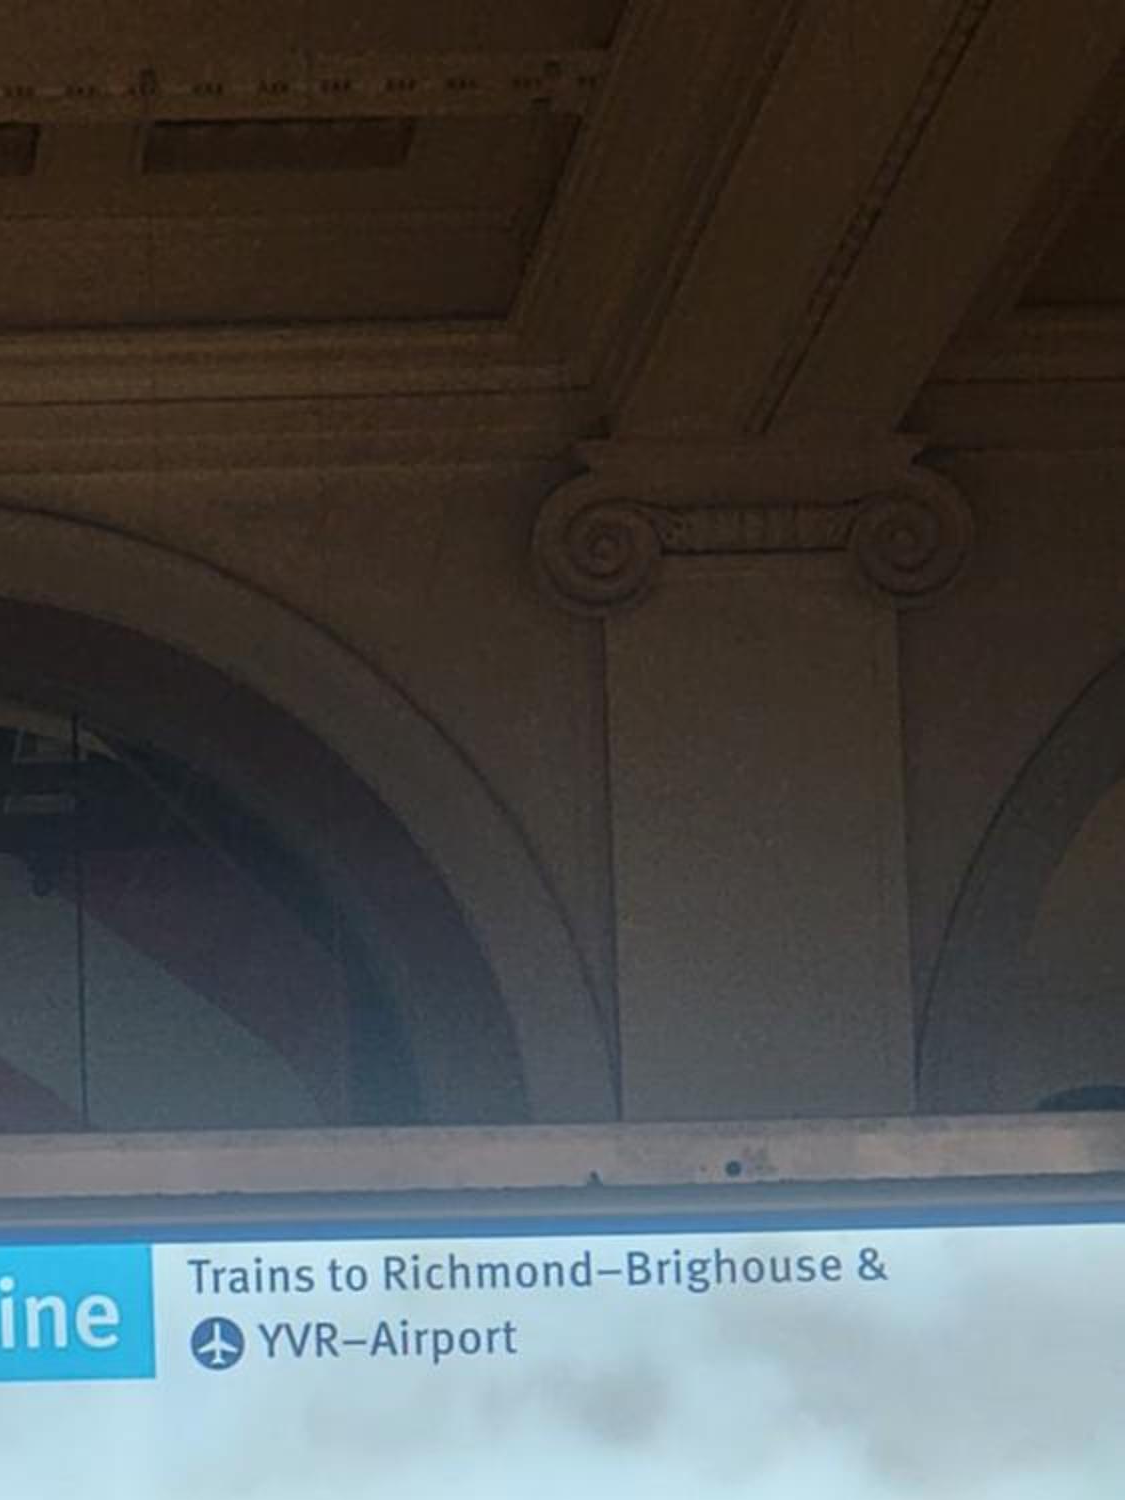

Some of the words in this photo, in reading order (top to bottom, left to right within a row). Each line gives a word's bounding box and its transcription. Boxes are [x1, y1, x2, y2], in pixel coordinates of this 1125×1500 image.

[187, 1256, 315, 1295] Trains
[327, 1257, 369, 1292] to
[857, 1247, 889, 1282] &
